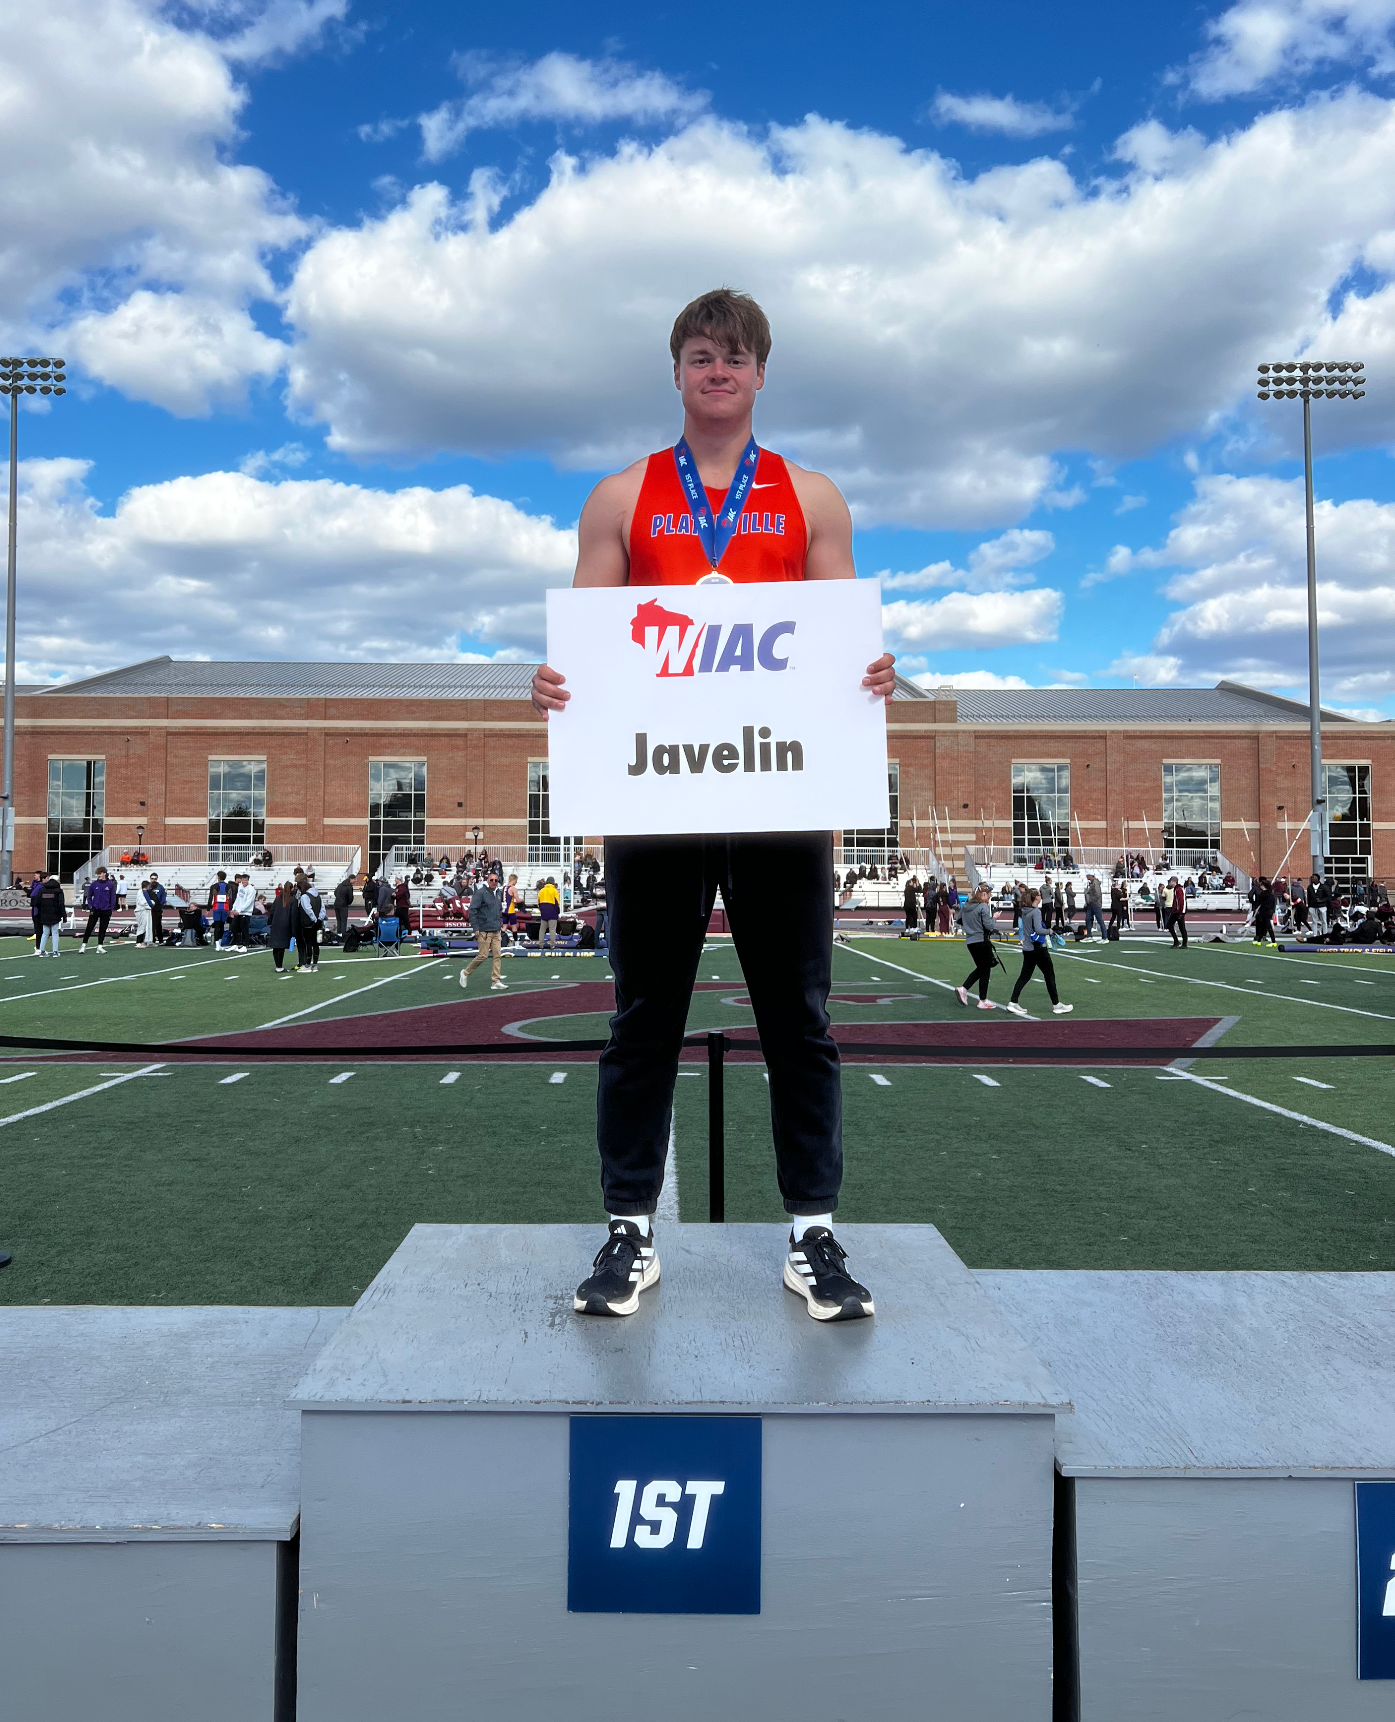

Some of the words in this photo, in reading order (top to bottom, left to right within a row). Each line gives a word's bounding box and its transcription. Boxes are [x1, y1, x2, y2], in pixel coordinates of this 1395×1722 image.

[688, 483, 699, 500] PLACE
[643, 620, 797, 675] WIAC
[627, 725, 804, 777] Javelin
[610, 1480, 725, 1549] 1ST
